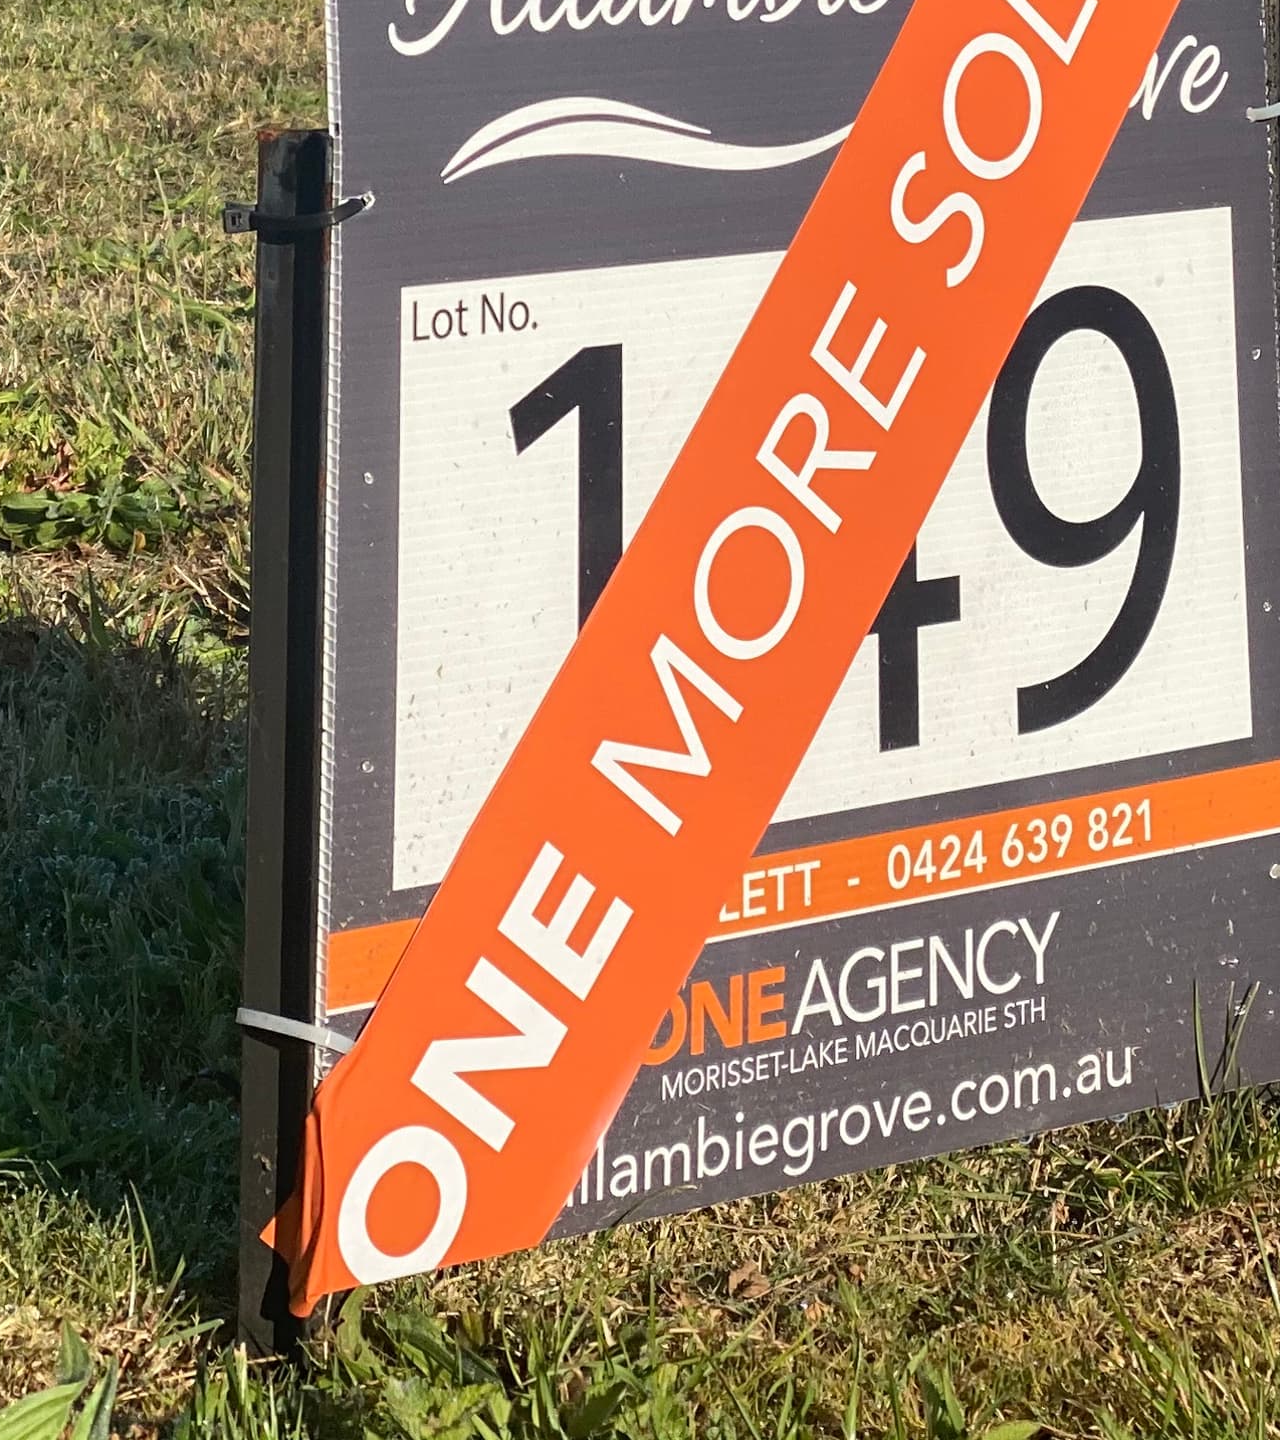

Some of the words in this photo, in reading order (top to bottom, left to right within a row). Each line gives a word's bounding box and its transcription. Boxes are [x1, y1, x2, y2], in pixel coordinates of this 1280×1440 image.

[412, 299, 469, 342] Lot
[481, 291, 539, 335] No.
[337, 840, 635, 1286] ONE
[591, 280, 927, 837] MORE
[886, 830, 988, 890] 0424
[1001, 812, 1074, 869] 639
[1086, 797, 1153, 852] 821
[660, 1037, 849, 1102] MORISSET-LAKE
[854, 1008, 998, 1060] MACQUARIE
[1002, 996, 1048, 1030] STH
[565, 1046, 1135, 1208] llambiegrove.com.au
